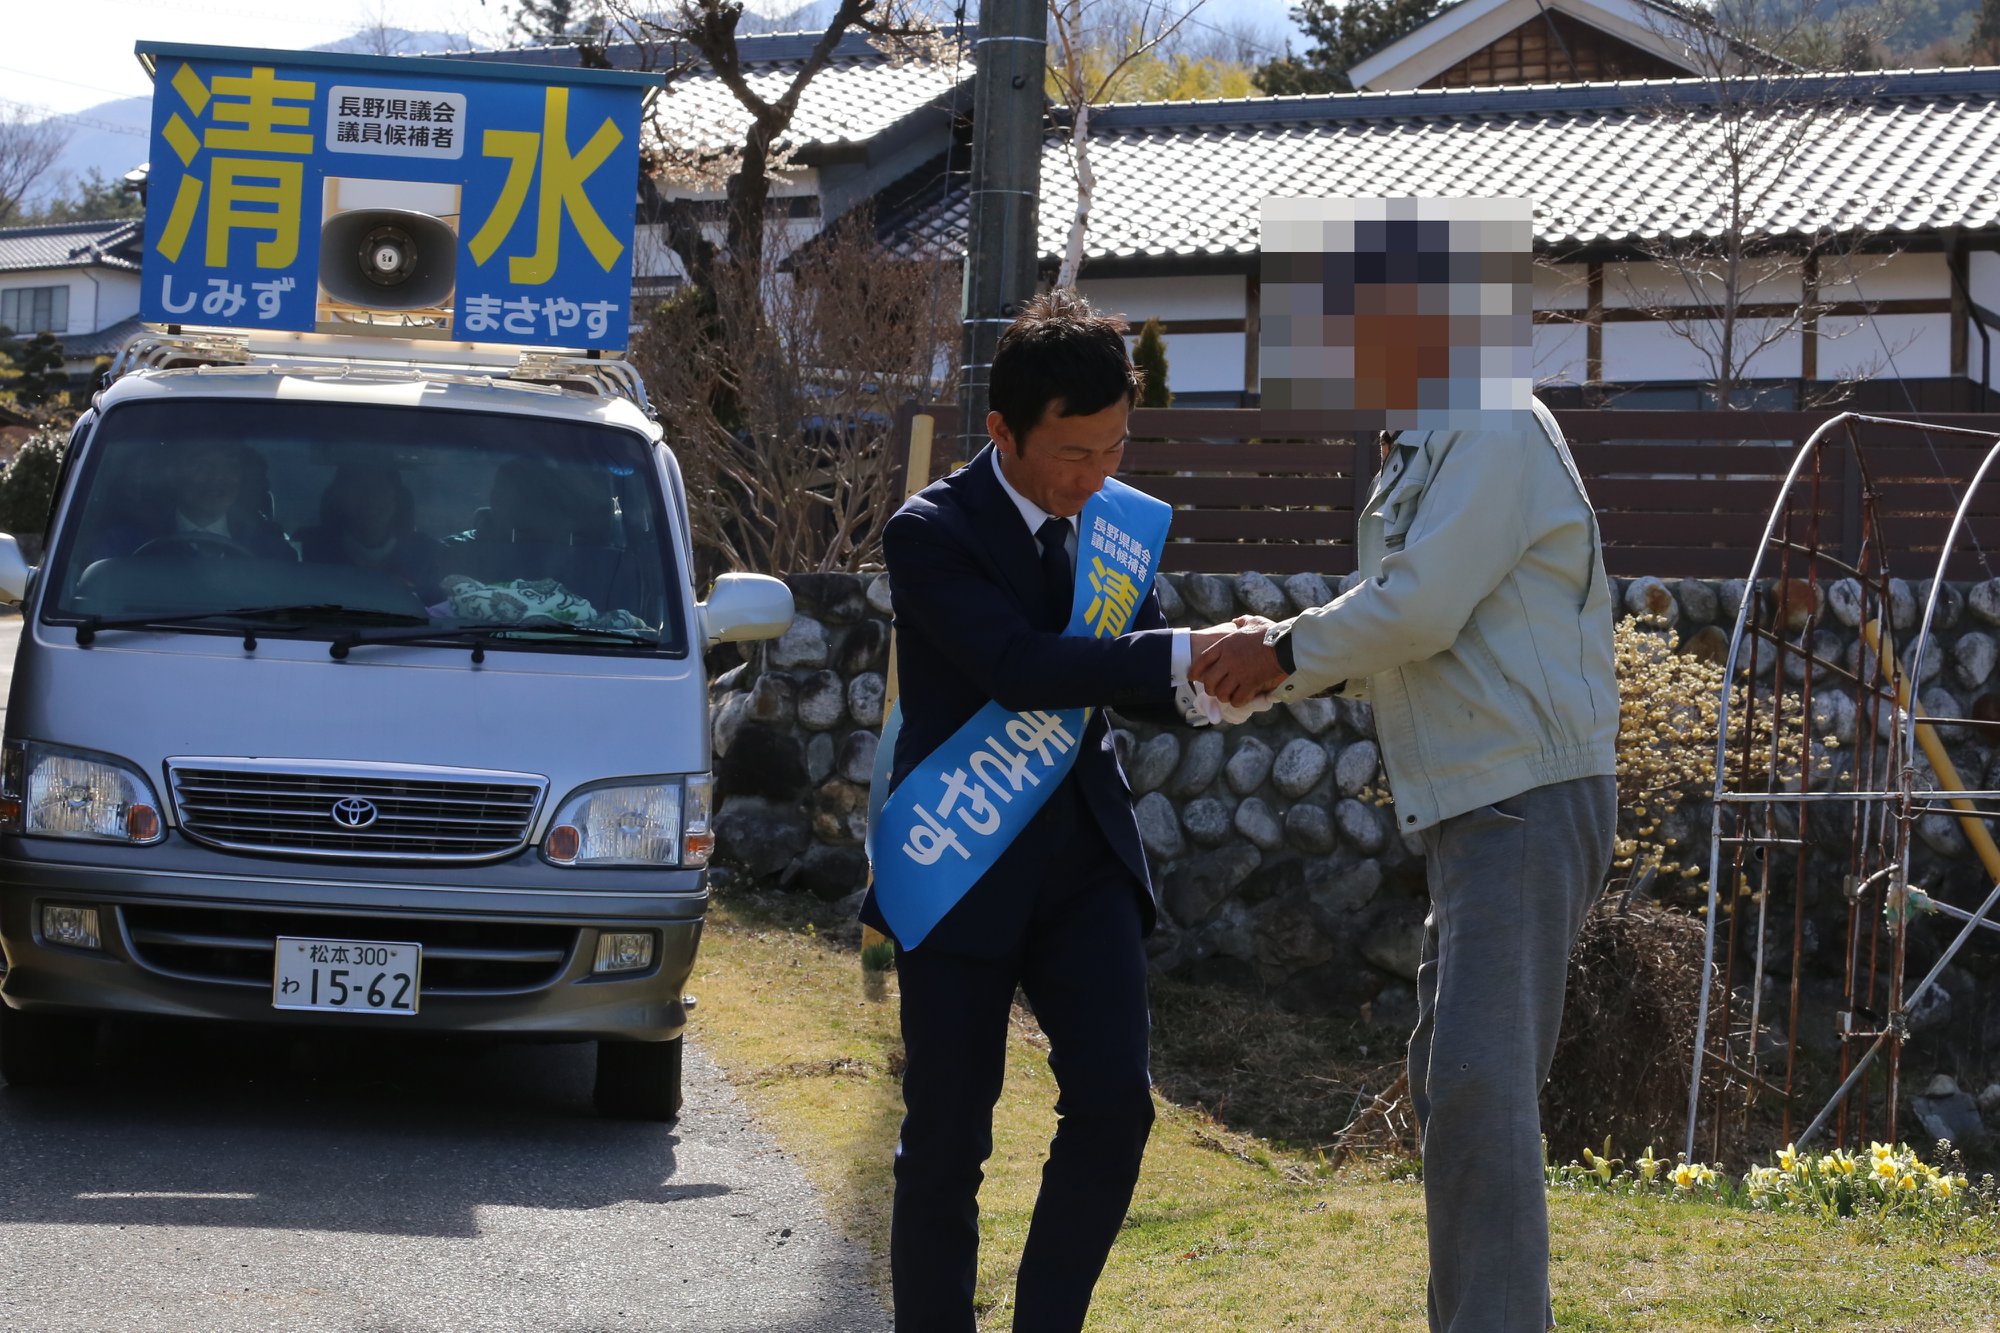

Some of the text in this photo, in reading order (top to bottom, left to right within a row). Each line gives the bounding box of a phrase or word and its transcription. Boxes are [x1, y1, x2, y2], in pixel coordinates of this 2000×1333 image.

[337, 121, 454, 148] 議員候補者
[338, 96, 456, 123] 長野県議会
[157, 63, 625, 285] 清 水
[161, 275, 619, 339] しみず まさやす
[1090, 532, 1148, 583] 議員候補者
[1093, 516, 1152, 566] 長野県議会
[1083, 555, 1140, 640] 清
[902, 710, 1076, 866] まさやす
[281, 969, 411, 1009] わ 15-62
